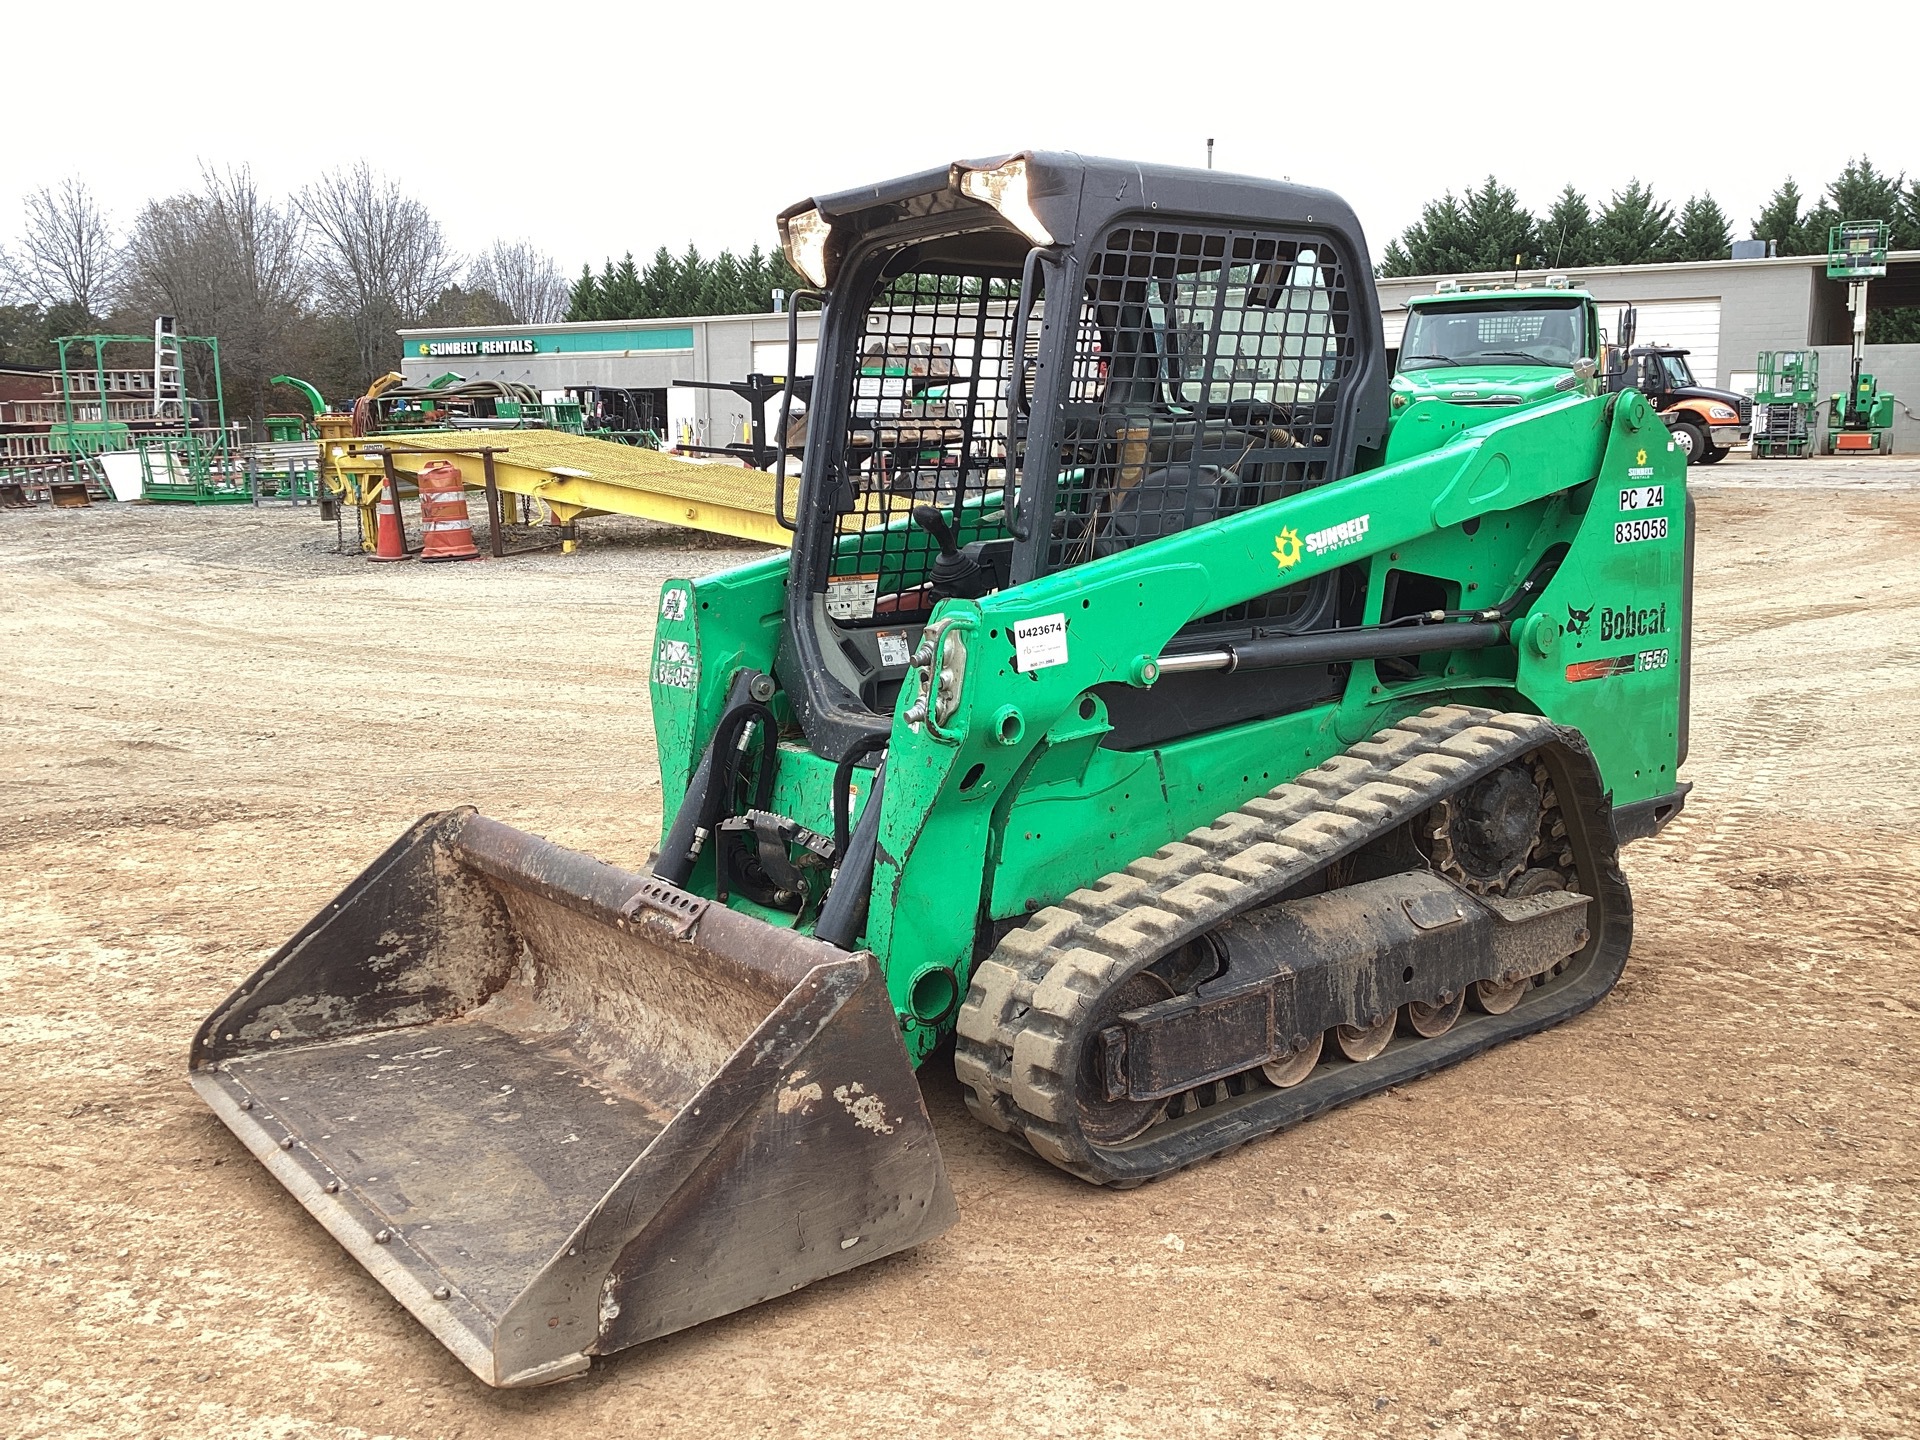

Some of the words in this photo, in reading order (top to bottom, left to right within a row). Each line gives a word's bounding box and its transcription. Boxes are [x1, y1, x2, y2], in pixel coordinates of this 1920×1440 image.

[429, 341, 478, 355] SUNBELT
[482, 339, 533, 354] RENTALS
[1620, 489, 1638, 510] PC
[1647, 486, 1663, 507] 24
[1305, 513, 1370, 553] SUNBELT
[1615, 518, 1667, 543] 835058
[1316, 534, 1363, 557] RENTALS
[1018, 622, 1062, 639] U423674
[1600, 602, 1666, 641] Bobcat
[1638, 648, 1669, 673] T550
